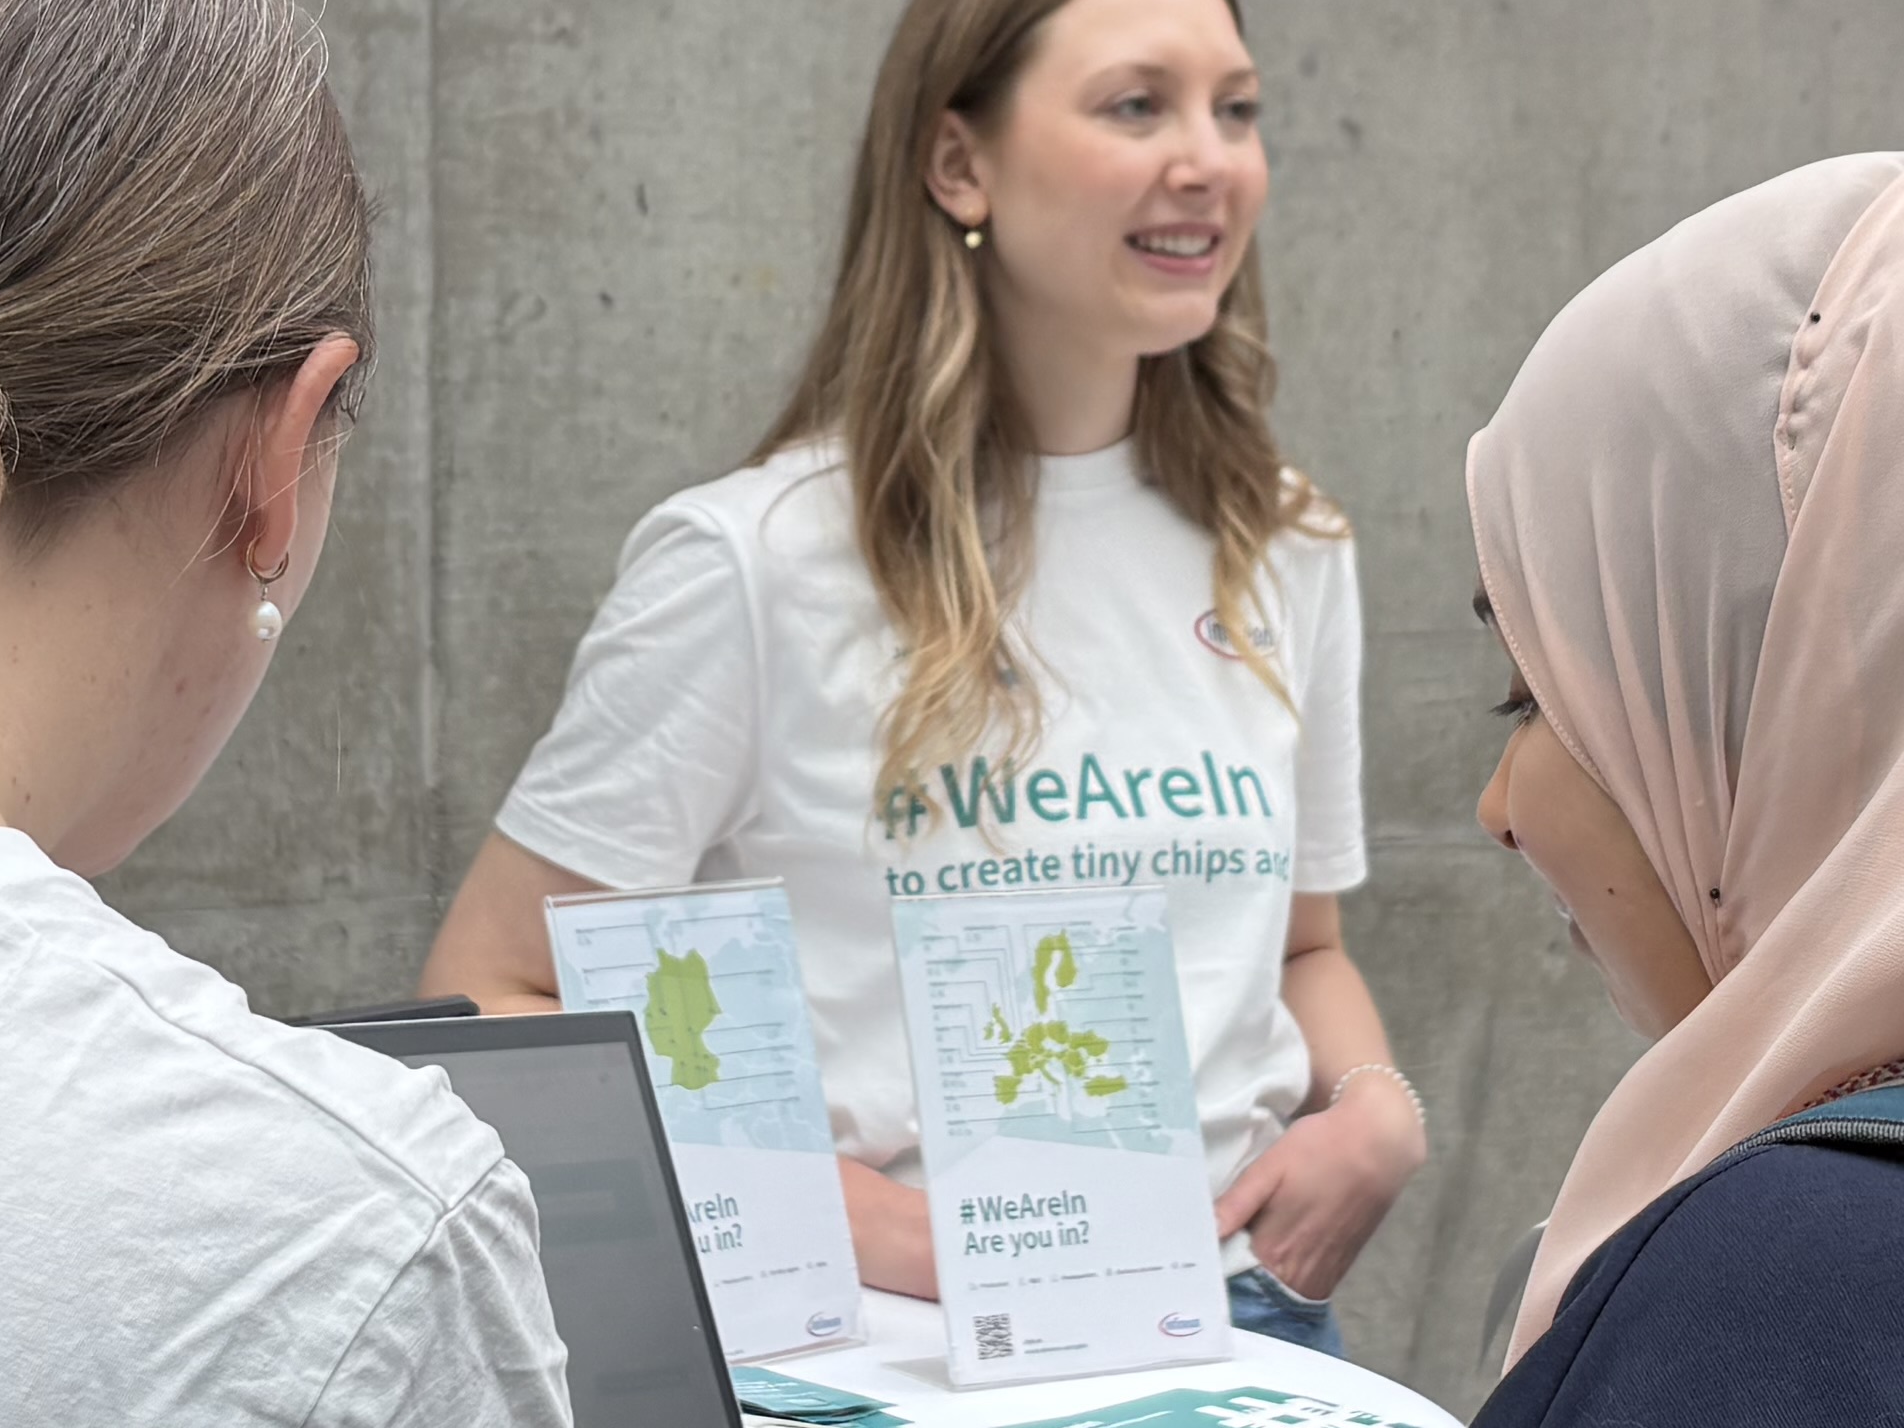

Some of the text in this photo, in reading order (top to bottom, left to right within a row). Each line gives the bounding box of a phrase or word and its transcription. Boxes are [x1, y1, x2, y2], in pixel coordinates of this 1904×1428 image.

[876, 749, 1273, 840] #WeAreIn
[885, 866, 925, 896] to
[937, 849, 1062, 892] create
[1071, 841, 1142, 886] tiny
[1151, 838, 1246, 883] chips
[960, 1189, 1087, 1224] #WeAreIn
[714, 1223, 744, 1252] in?
[964, 1220, 1090, 1258] Are you in?
